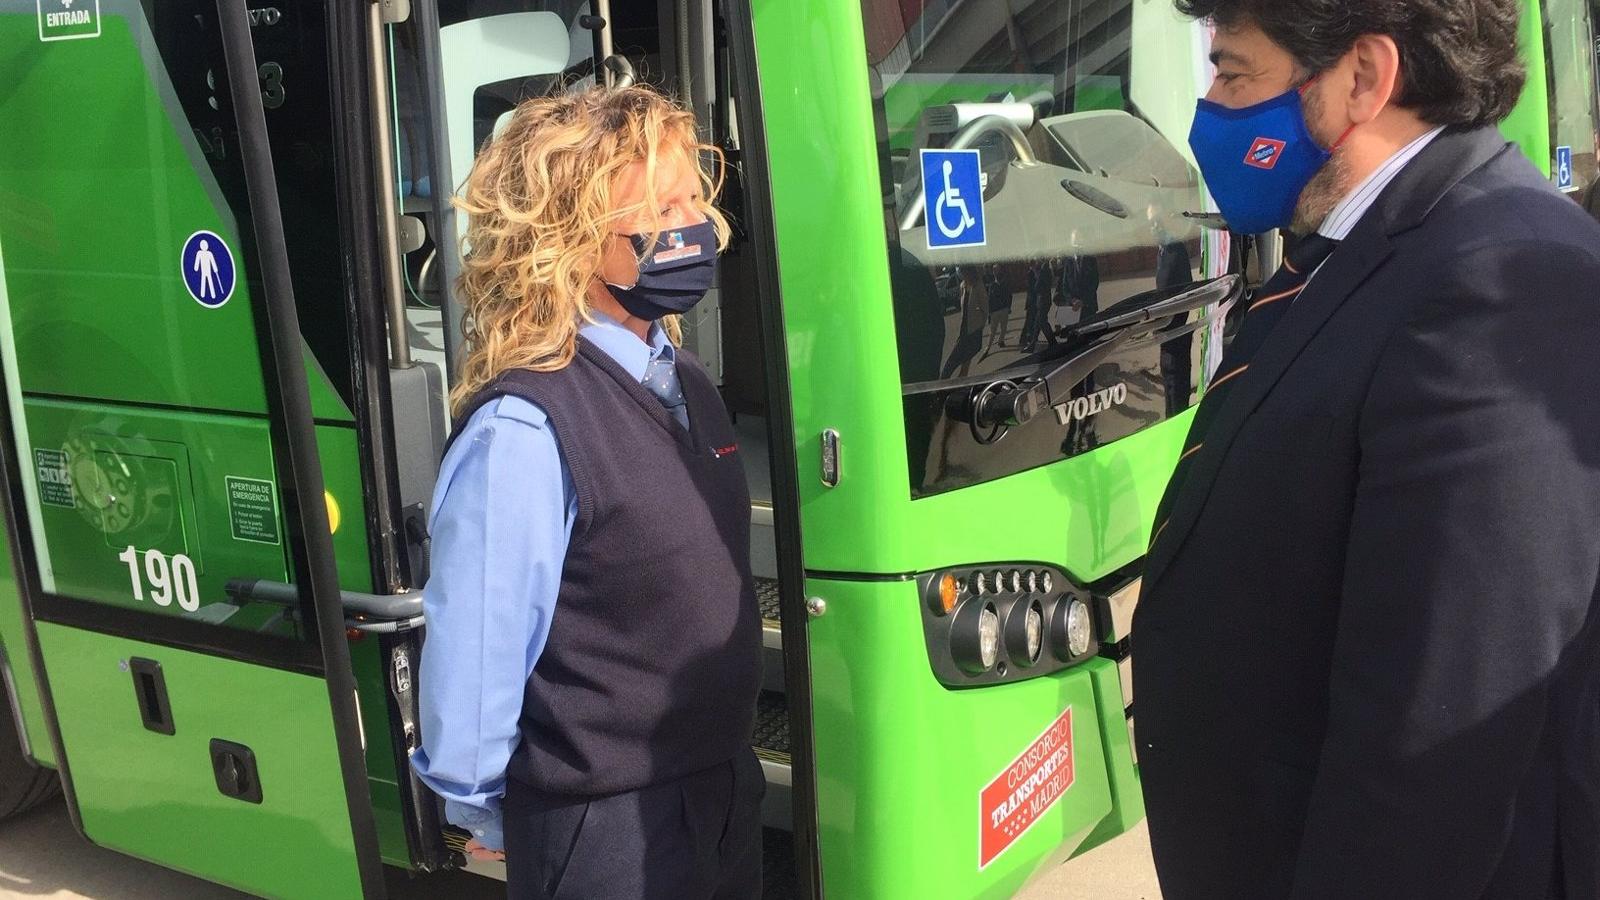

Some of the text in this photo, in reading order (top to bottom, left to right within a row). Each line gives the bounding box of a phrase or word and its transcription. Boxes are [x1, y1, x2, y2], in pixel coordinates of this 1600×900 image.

[46, 10, 91, 27] ENTRADA
[1054, 382, 1127, 425] VOLVO
[230, 482, 270, 494] APERTURA DE
[232, 490, 270, 503] EMERGENCIA
[119, 545, 200, 612] 190
[1007, 718, 1068, 789] CONSORCIO
[991, 741, 1069, 829] TRANSPORTES
[1029, 765, 1071, 819] MADRID
